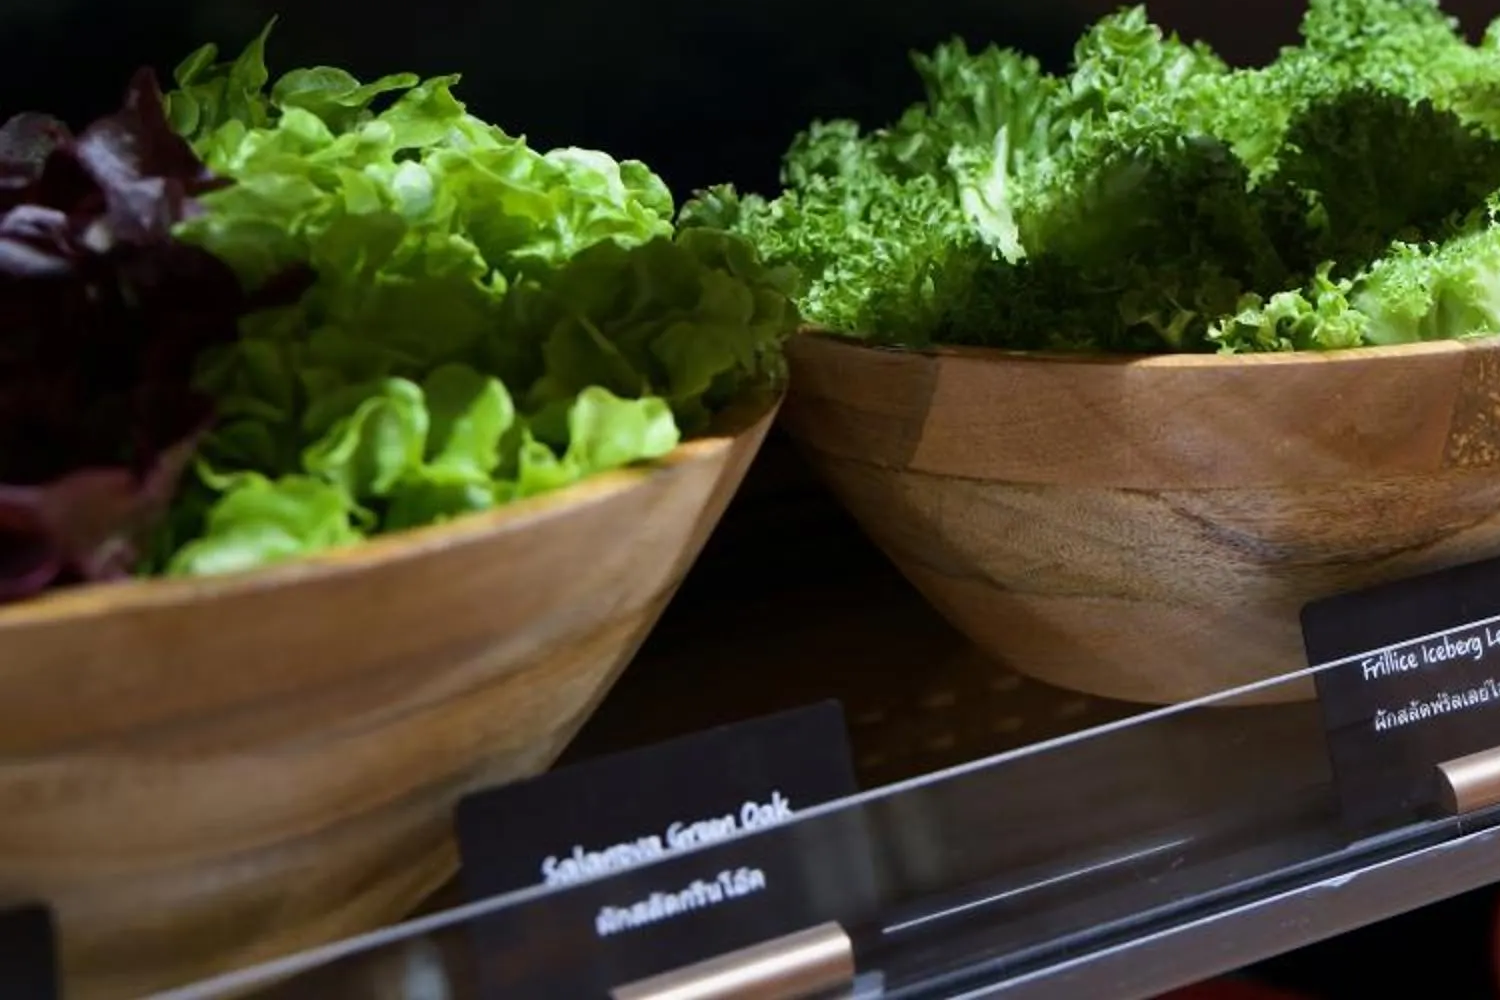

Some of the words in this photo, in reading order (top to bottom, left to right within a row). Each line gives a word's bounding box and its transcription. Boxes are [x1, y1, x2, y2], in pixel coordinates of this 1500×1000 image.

[1361, 648, 1418, 681] Frillice
[1423, 636, 1483, 665] Iceberg
[741, 791, 793, 832] Oak
